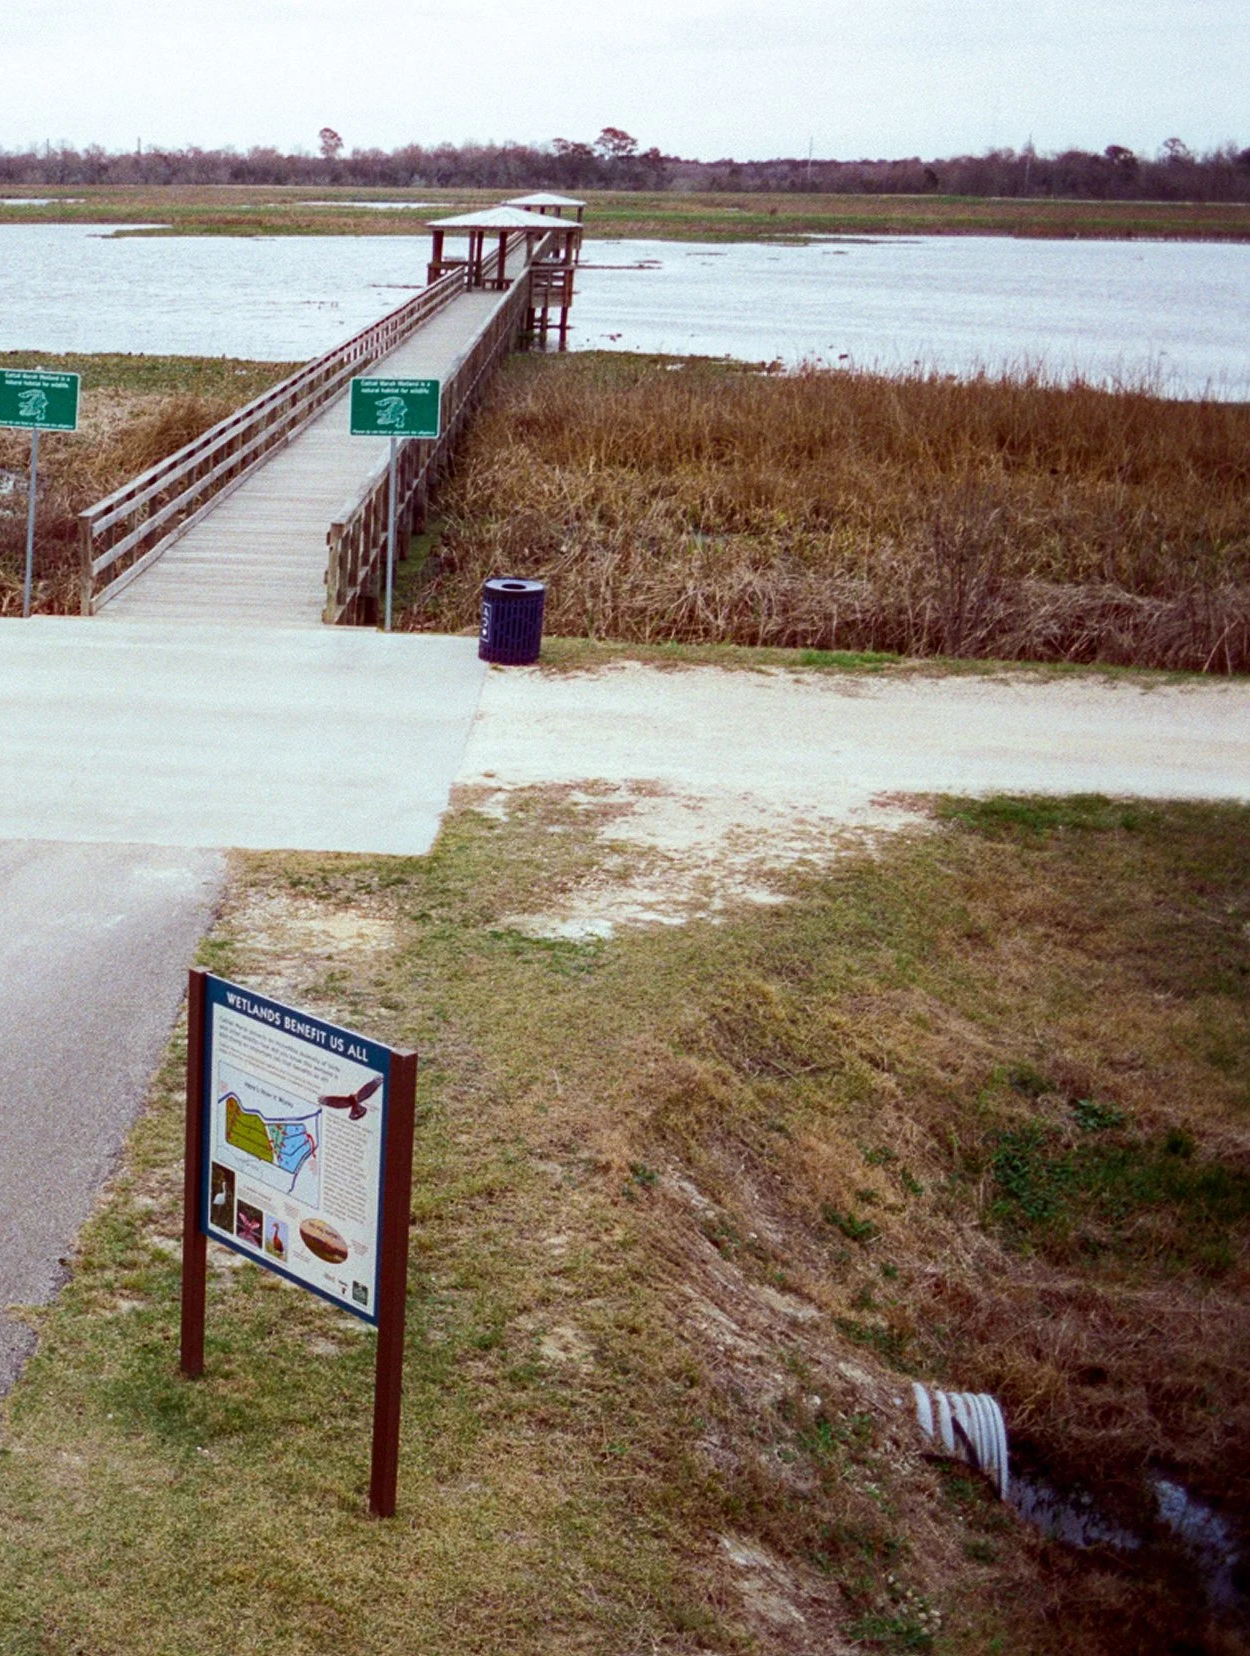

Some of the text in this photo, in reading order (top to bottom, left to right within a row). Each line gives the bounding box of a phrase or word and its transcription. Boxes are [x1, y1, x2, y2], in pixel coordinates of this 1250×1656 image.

[226, 992, 281, 1025] WETLANDS
[284, 1016, 327, 1045] BENEFIT
[329, 1035, 345, 1052] US
[347, 1044, 369, 1062] ALL
